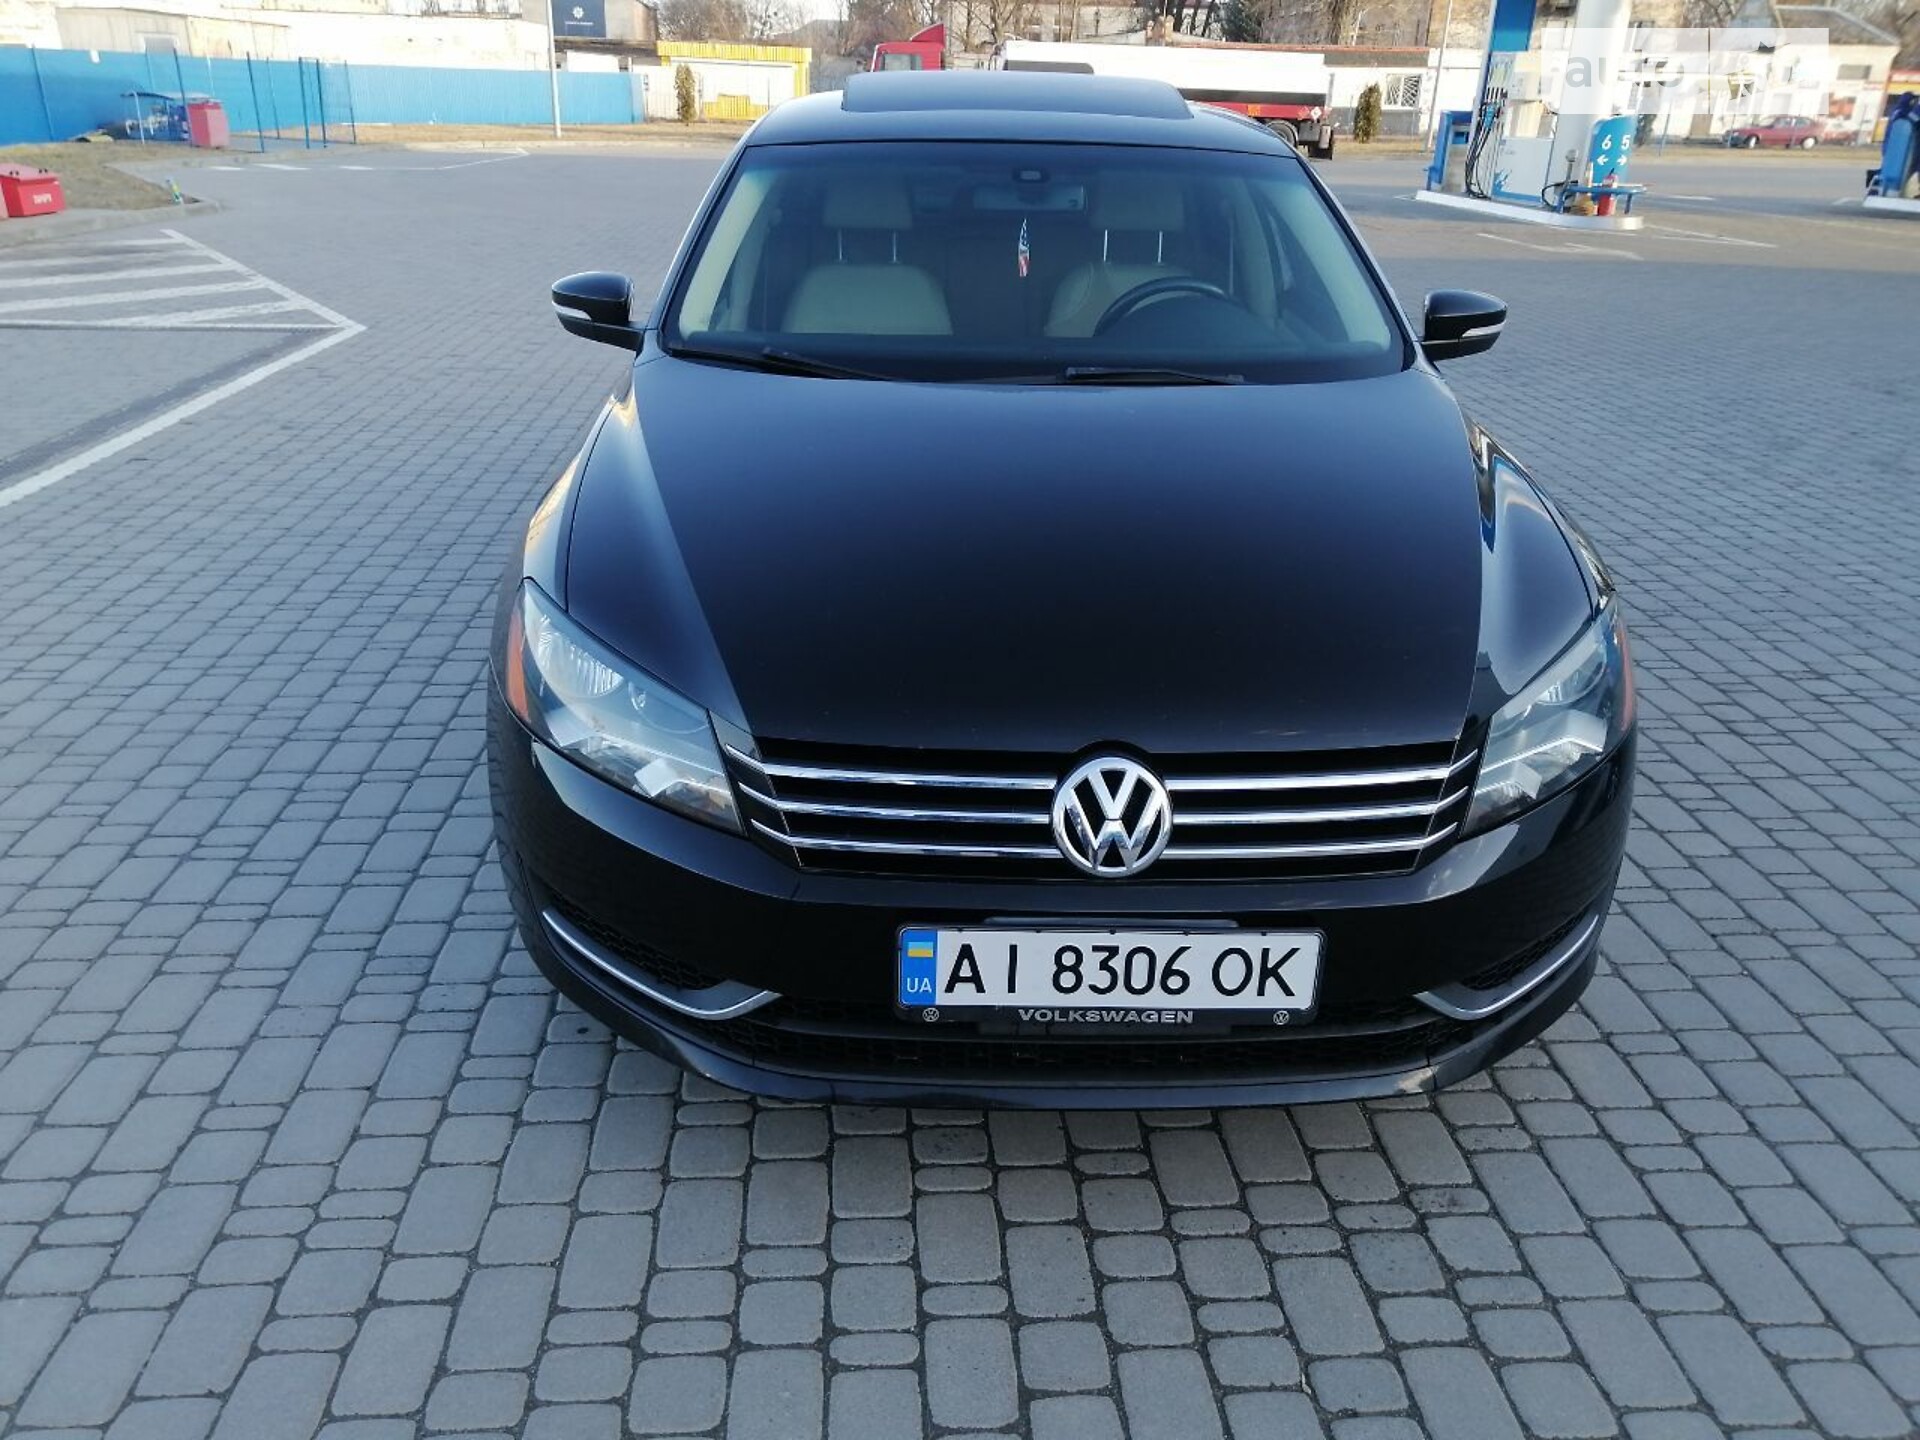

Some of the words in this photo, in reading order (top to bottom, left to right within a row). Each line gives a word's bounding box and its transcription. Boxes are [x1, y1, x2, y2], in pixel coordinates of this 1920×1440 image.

[1601, 134, 1612, 151] 6
[1621, 134, 1631, 151] 5
[1052, 944, 1193, 996] 8306
[1211, 947, 1301, 997] OK
[906, 977, 933, 994] UA
[1018, 1008, 1194, 1024] VOLKSWAGEN
